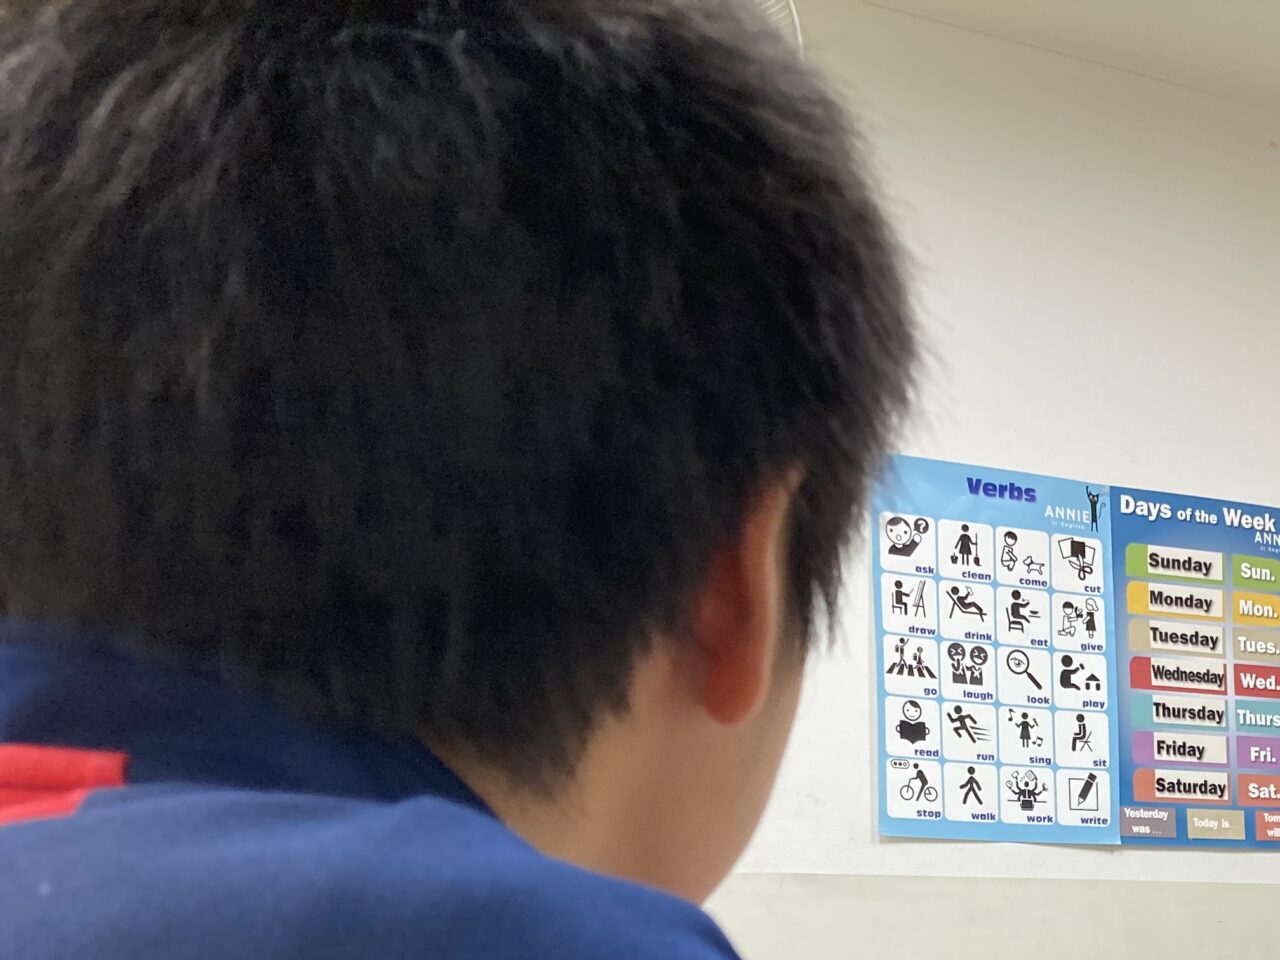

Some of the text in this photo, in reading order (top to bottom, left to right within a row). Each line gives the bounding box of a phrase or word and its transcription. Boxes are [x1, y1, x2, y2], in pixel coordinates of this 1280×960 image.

[967, 477, 1037, 502] Verbs
[1045, 505, 1090, 523] ANNIE
[1120, 495, 1276, 532] Days of the Week
[915, 564, 934, 574] ask
[1149, 552, 1212, 576] Sunday
[962, 570, 991, 581] clean
[1241, 562, 1275, 581] Sun.
[1019, 577, 1048, 588] come
[1084, 585, 1101, 594] cut
[1150, 590, 1212, 612] Monday
[1239, 600, 1277, 618] Mon.
[908, 625, 936, 636] draw
[964, 631, 992, 641] drink
[1030, 638, 1048, 647] eat
[1150, 627, 1218, 649] Tuesday
[1080, 642, 1103, 652] give
[1238, 636, 1280, 654] Tues.
[1152, 665, 1224, 687] Wednesday
[1240, 673, 1280, 690] Wed.
[924, 687, 937, 696] go
[963, 690, 993, 701] laugh
[1027, 695, 1050, 705] look
[1082, 699, 1105, 709] play
[1153, 703, 1224, 724] Thursday
[914, 748, 939, 757] read
[1156, 740, 1204, 760] Friday
[1250, 747, 1276, 763] Fri.
[977, 753, 994, 761] run
[1029, 756, 1051, 766] sing
[1093, 758, 1107, 767] sit
[1156, 778, 1226, 798] Saturday
[1248, 784, 1280, 799] Sat.
[917, 808, 941, 819] stop
[971, 812, 996, 821] walk
[1027, 814, 1053, 823] work
[1124, 808, 1168, 821] Yesterday
[1080, 815, 1108, 825] write
[1193, 818, 1218, 829] Today
[1267, 828, 1280, 837] will
